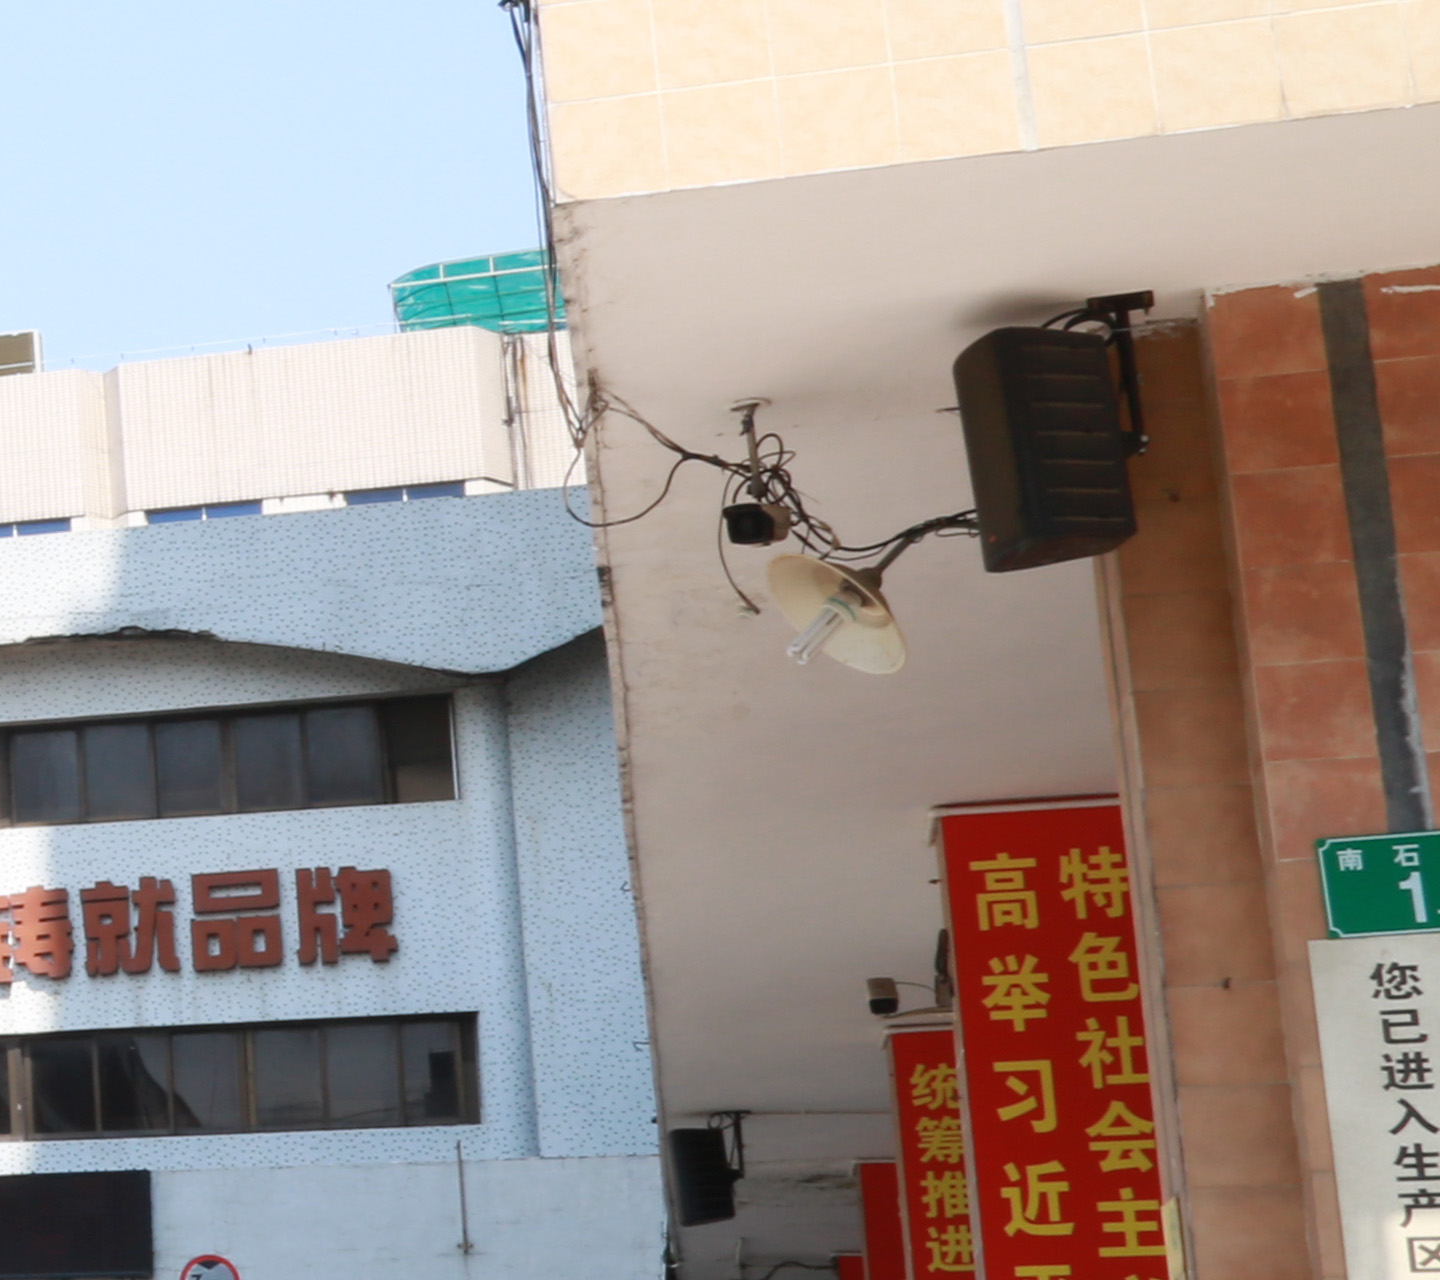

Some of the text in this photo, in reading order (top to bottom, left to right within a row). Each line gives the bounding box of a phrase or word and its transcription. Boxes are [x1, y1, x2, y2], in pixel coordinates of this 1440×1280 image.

[1336, 843, 1420, 871] 南石
[1399, 870, 1440, 924] 1
[1369, 961, 1440, 1273] 您已进入生产区
